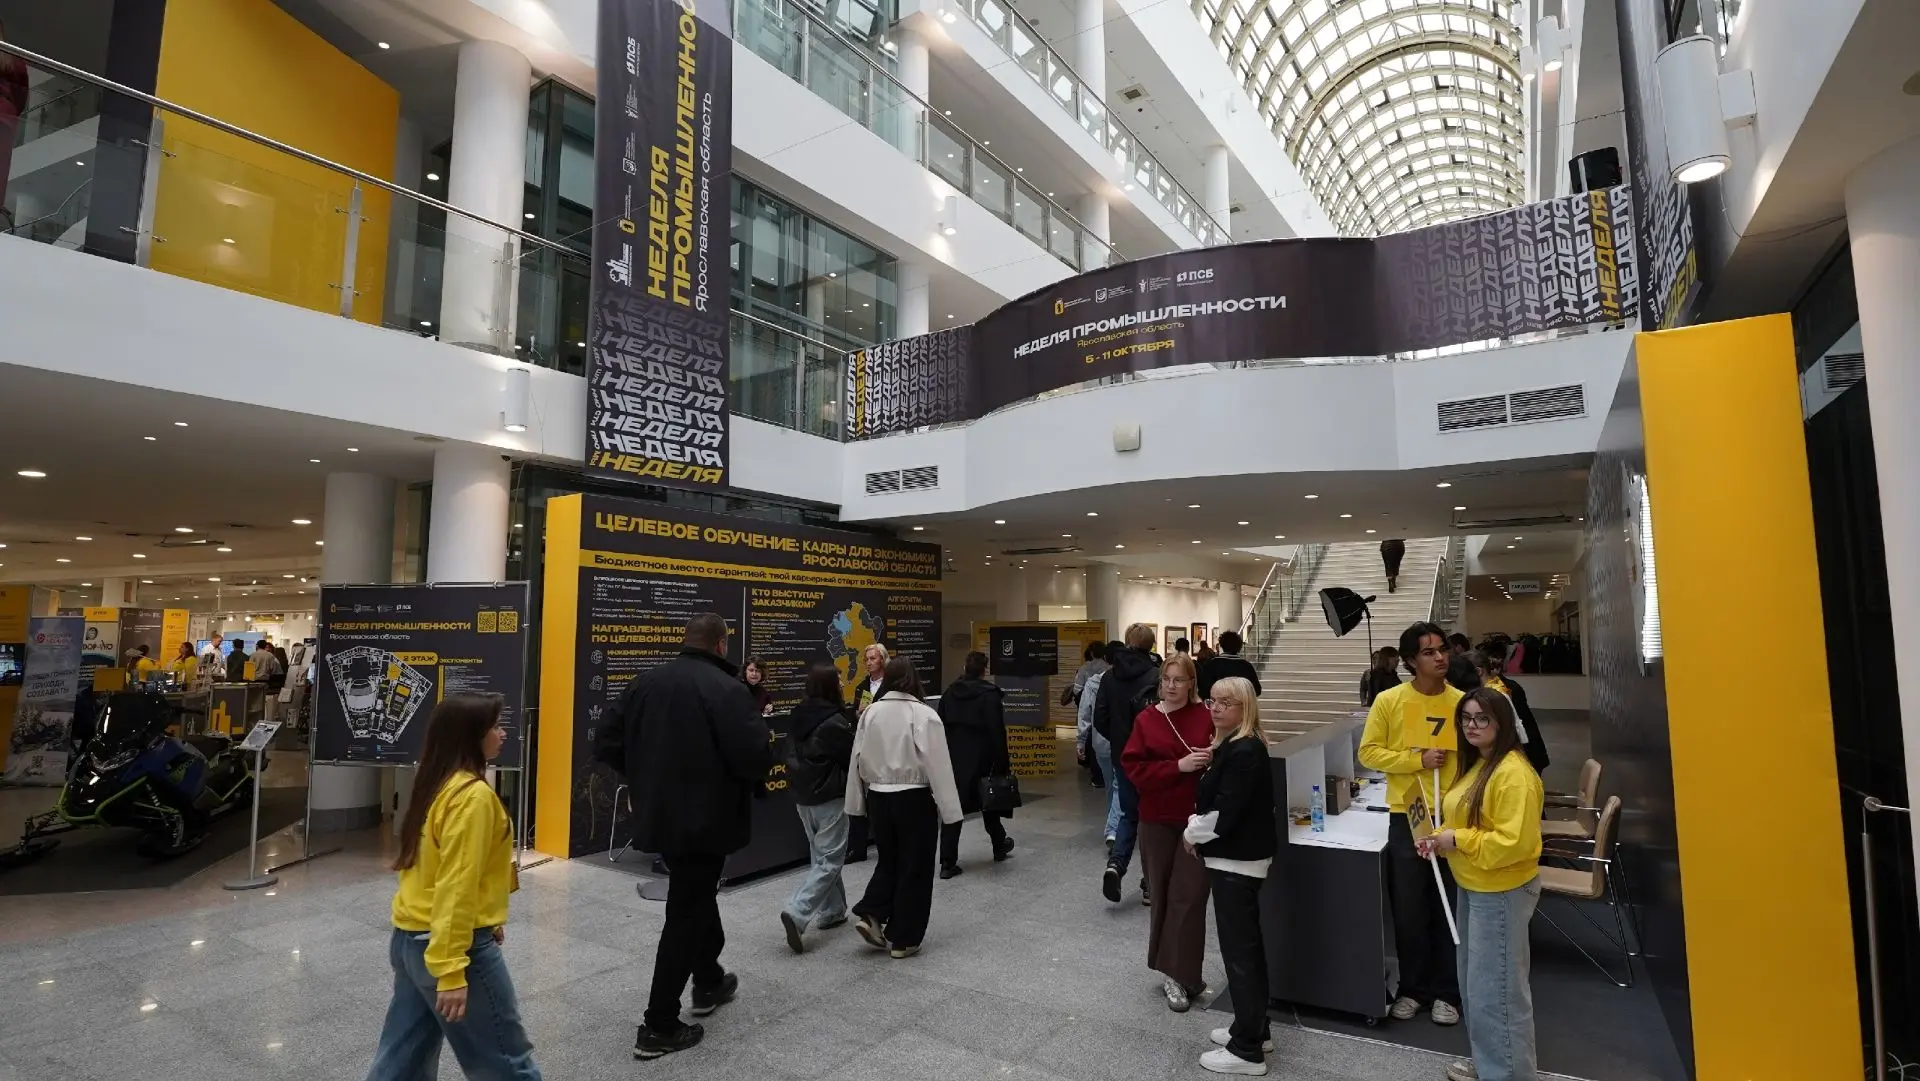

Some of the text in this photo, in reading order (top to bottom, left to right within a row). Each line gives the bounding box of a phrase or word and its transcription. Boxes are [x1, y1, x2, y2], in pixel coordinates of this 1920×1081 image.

[648, 145, 670, 299] НЕДЕЛЯ
[696, 93, 713, 313] Ярославская область
[1497, 211, 1523, 326] НЕДЕЛЯ
[1516, 206, 1542, 320] НЕДЕЛЯ
[1534, 200, 1561, 320] НЕДЕЛЯ
[1554, 198, 1580, 314] НЕДЕЛЯ
[1572, 192, 1600, 312] НЕДЕЛЯ
[1590, 190, 1619, 309] НЕДЕЛЯ
[1610, 184, 1639, 307] НЕДЕЛЯ
[1188, 268, 1214, 281] ПСБ
[1444, 224, 1467, 333] НЕДЕЛЯ
[1461, 221, 1485, 331] НЕДЕЛЯ
[1479, 217, 1504, 327] НЕДЕЛЯ
[602, 309, 723, 358] НЕДЕЛЯ
[1013, 295, 1287, 359] НЕДЕЛЯ ПРОМЫШЛЕННОСТИ
[1076, 320, 1185, 348] Ярославская область
[1565, 314, 1582, 324] СТИ
[1585, 310, 1603, 323] ПРО
[1647, 299, 1660, 323] ПРО
[600, 348, 724, 395] НЕДЕЛЯ
[601, 331, 723, 374] НЕДЕЛЯ
[1085, 353, 1094, 364] 5
[1102, 350, 1112, 360] 11
[1112, 339, 1175, 357] ОКТЯБРЯ
[600, 372, 724, 411] НЕДЕЛЯ
[847, 354, 856, 431] НЕДЕЛЯ
[856, 350, 864, 430] НЕДЕЛЯ
[865, 348, 873, 428] НЕДЕЛЯ
[873, 345, 882, 427] НЕДЕЛЯ
[882, 343, 891, 426] НЕДЕЛЯ
[891, 341, 901, 425] НЕДЕЛЯ
[901, 341, 910, 421] НЕДЕЛЯ
[910, 337, 919, 420] НЕДЕЛЯ
[919, 335, 928, 417] НЕДЕЛЯ
[599, 412, 723, 447] НЕДЕЛЯ
[600, 390, 724, 431] НЕДЕЛЯ
[599, 431, 723, 467] НЕДЕЛЯ
[599, 452, 723, 484] НЕДЕЛЯ
[595, 512, 799, 552] ЦЕЛЕВОЕ ОБУЧЕНИЕ:
[802, 540, 936, 563] КАДРЫ ДЛЯ ЭКОНОМИКИ
[594, 554, 668, 571] Бюджетное
[670, 563, 705, 574] место
[715, 567, 767, 579] гарантией:
[770, 573, 790, 581] твой
[792, 574, 837, 585] карьерный
[838, 577, 860, 586] старт
[867, 578, 910, 589] Ярославской
[802, 555, 937, 575] ЯРОСЛАВСКОЙ ОБЛАСТИ
[752, 588, 825, 600] КТО ВЫСТУПАЕТ
[752, 599, 816, 608] ЗАКАЗЧИКОМ?
[329, 622, 471, 630] НЕДЕЛЯ ПРОМЫШЛЕННОСТИ
[591, 635, 607, 643] ПО
[610, 634, 661, 644] ЦЕЛЕВОЙ
[592, 624, 674, 634] НАПРАВЛЕНИЯ
[1426, 716, 1447, 737] 7
[1408, 796, 1426, 830] 26
